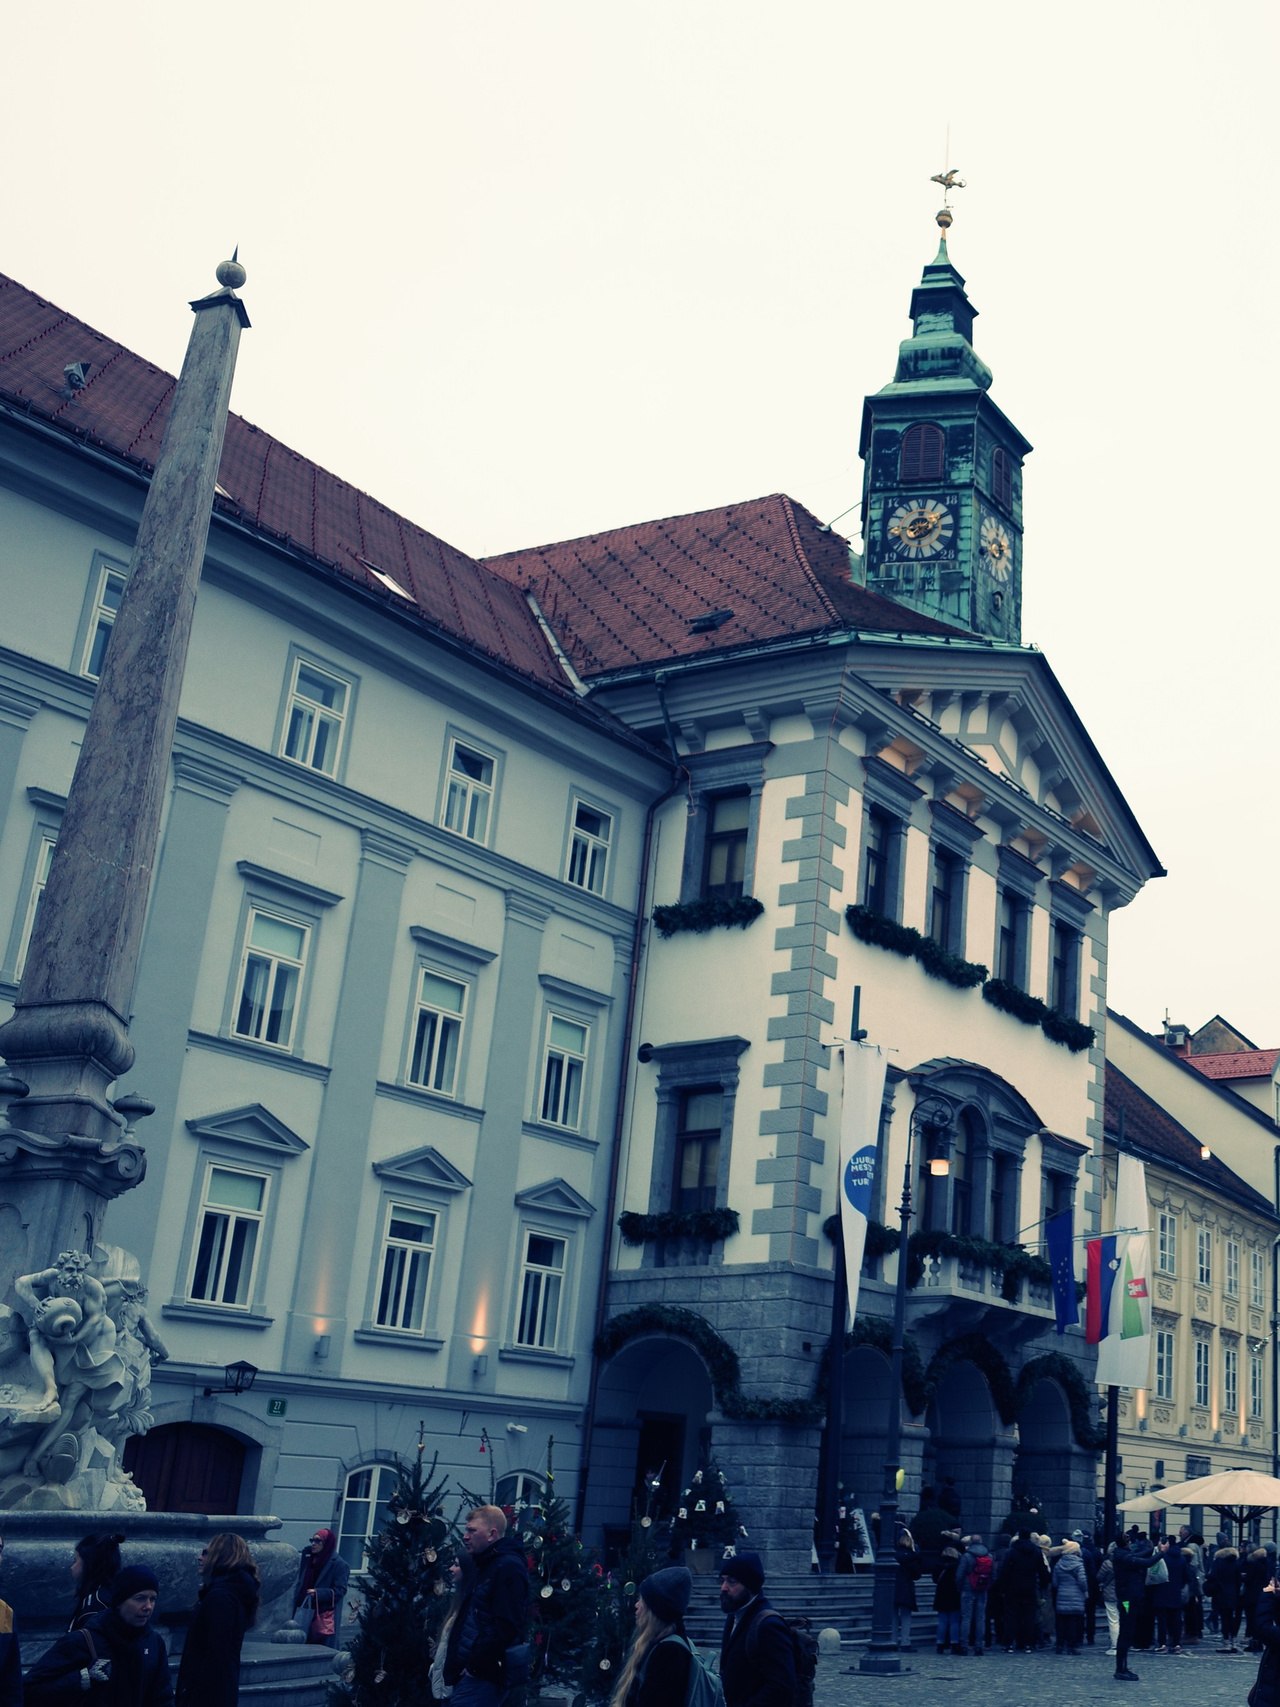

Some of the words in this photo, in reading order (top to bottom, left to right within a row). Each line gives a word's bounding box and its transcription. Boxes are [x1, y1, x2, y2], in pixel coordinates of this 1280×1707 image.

[887, 498, 899, 508] 17
[945, 495, 957, 505] 18
[884, 552, 897, 562] 19
[940, 549, 955, 560] 28
